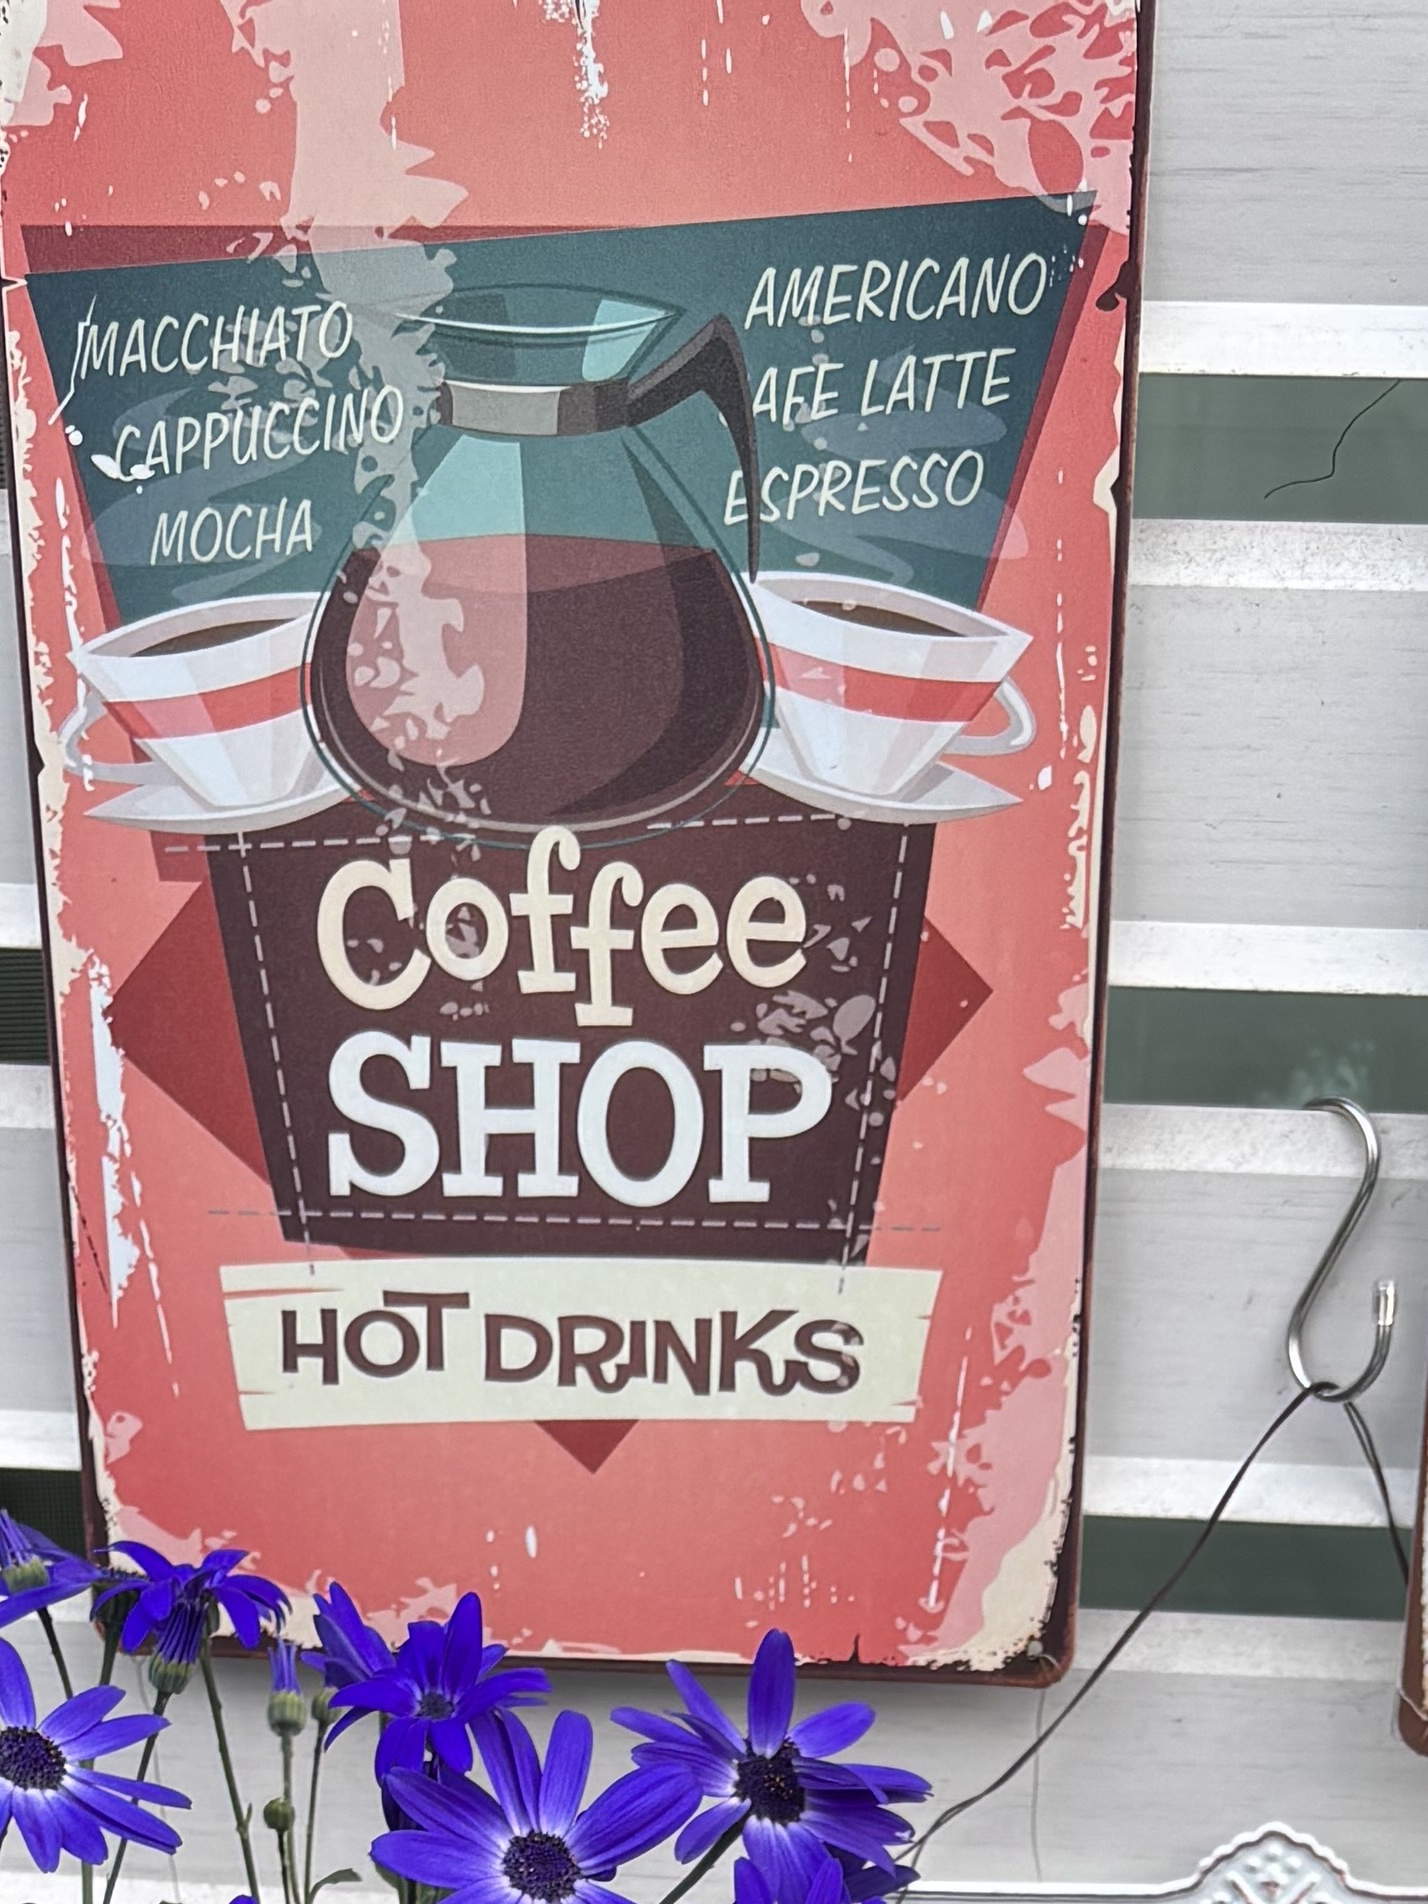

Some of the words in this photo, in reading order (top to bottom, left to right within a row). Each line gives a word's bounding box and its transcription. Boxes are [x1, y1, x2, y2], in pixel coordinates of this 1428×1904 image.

[743, 252, 1048, 330] AMERICANO
[80, 300, 354, 381] MACCHIATO
[719, 362, 845, 430] AFE
[860, 347, 1017, 417] LATTE
[112, 384, 404, 482] CAPPUCCINO
[723, 449, 985, 526] ESPRESSO
[149, 496, 313, 567] MOCHA
[316, 825, 808, 1027] Coffee
[327, 1030, 833, 1207] SHOP
[280, 1290, 470, 1387] HOT
[483, 1306, 862, 1396] DRINKS
